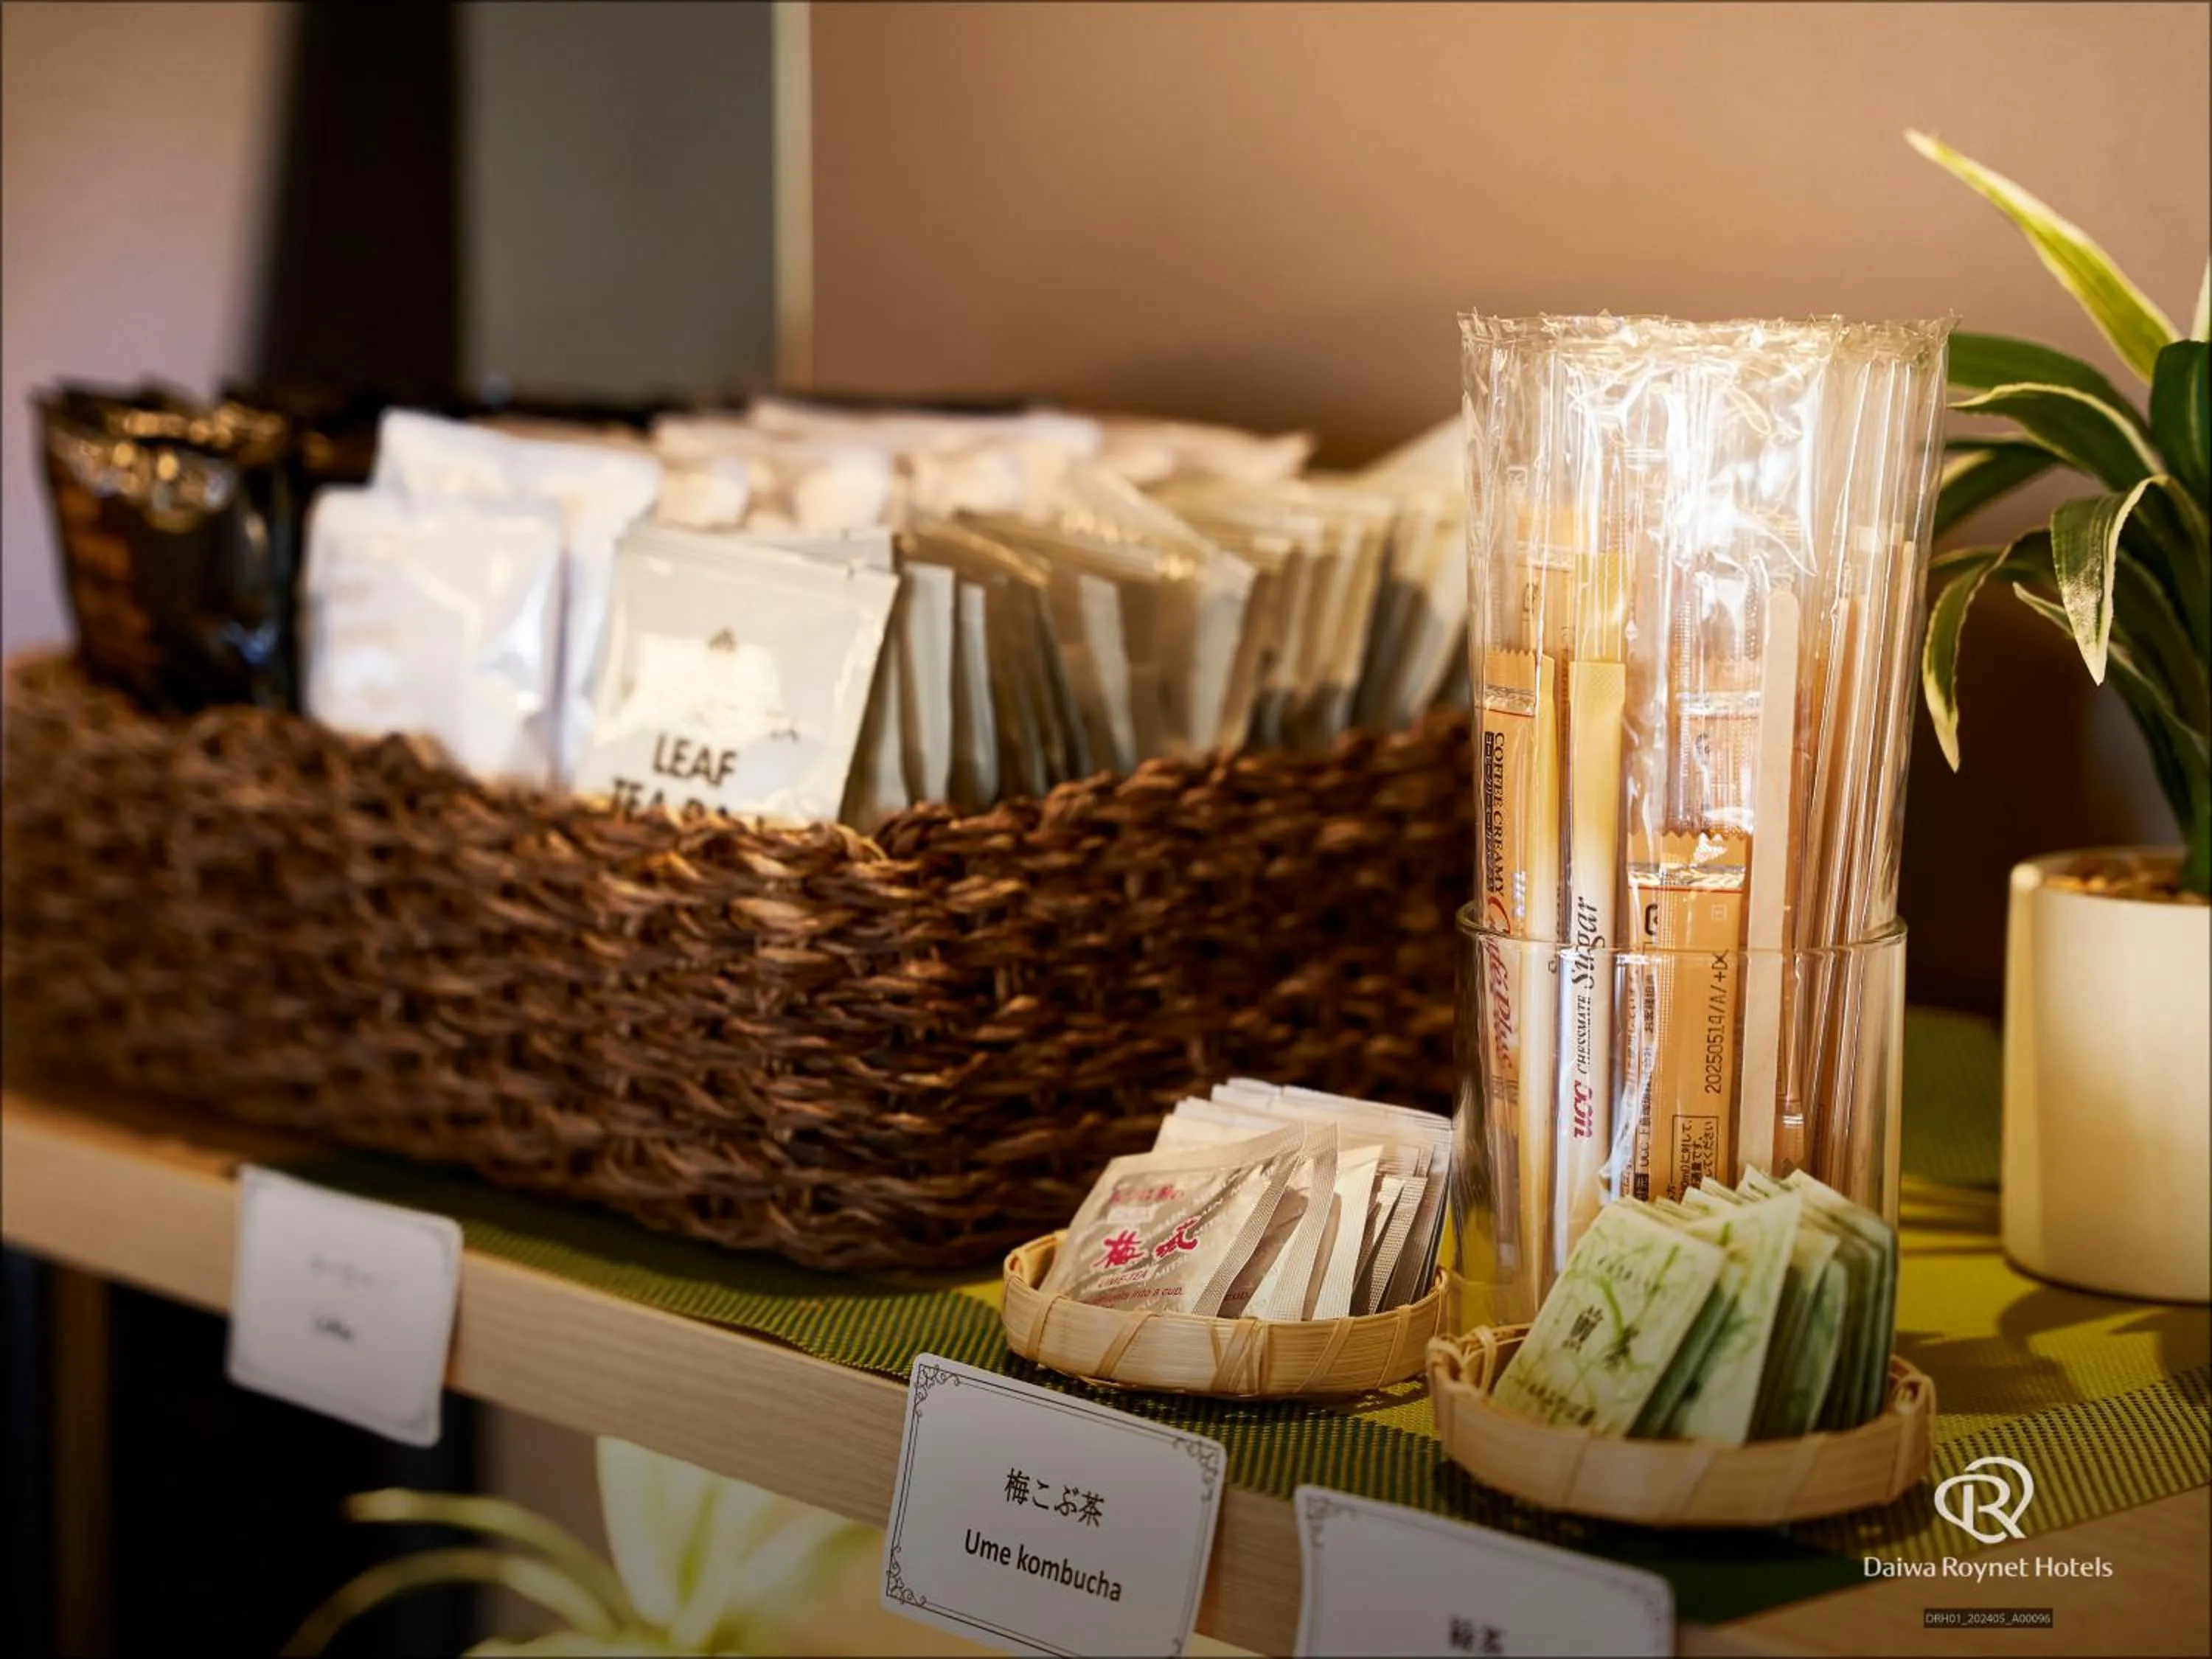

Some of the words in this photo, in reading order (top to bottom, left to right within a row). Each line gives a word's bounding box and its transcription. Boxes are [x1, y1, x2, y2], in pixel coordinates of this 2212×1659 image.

[653, 733, 737, 787] LEAF
[1492, 731, 1506, 809] COFFEE
[1492, 810, 1506, 897] CREAMY
[1571, 896, 1605, 990] Sugar
[1576, 994, 1592, 1074] CHESSMATE
[1004, 1466, 1105, 1528] 梅こぶ茶
[964, 1528, 1012, 1565] Ume
[1017, 1544, 1122, 1602] kombucha
